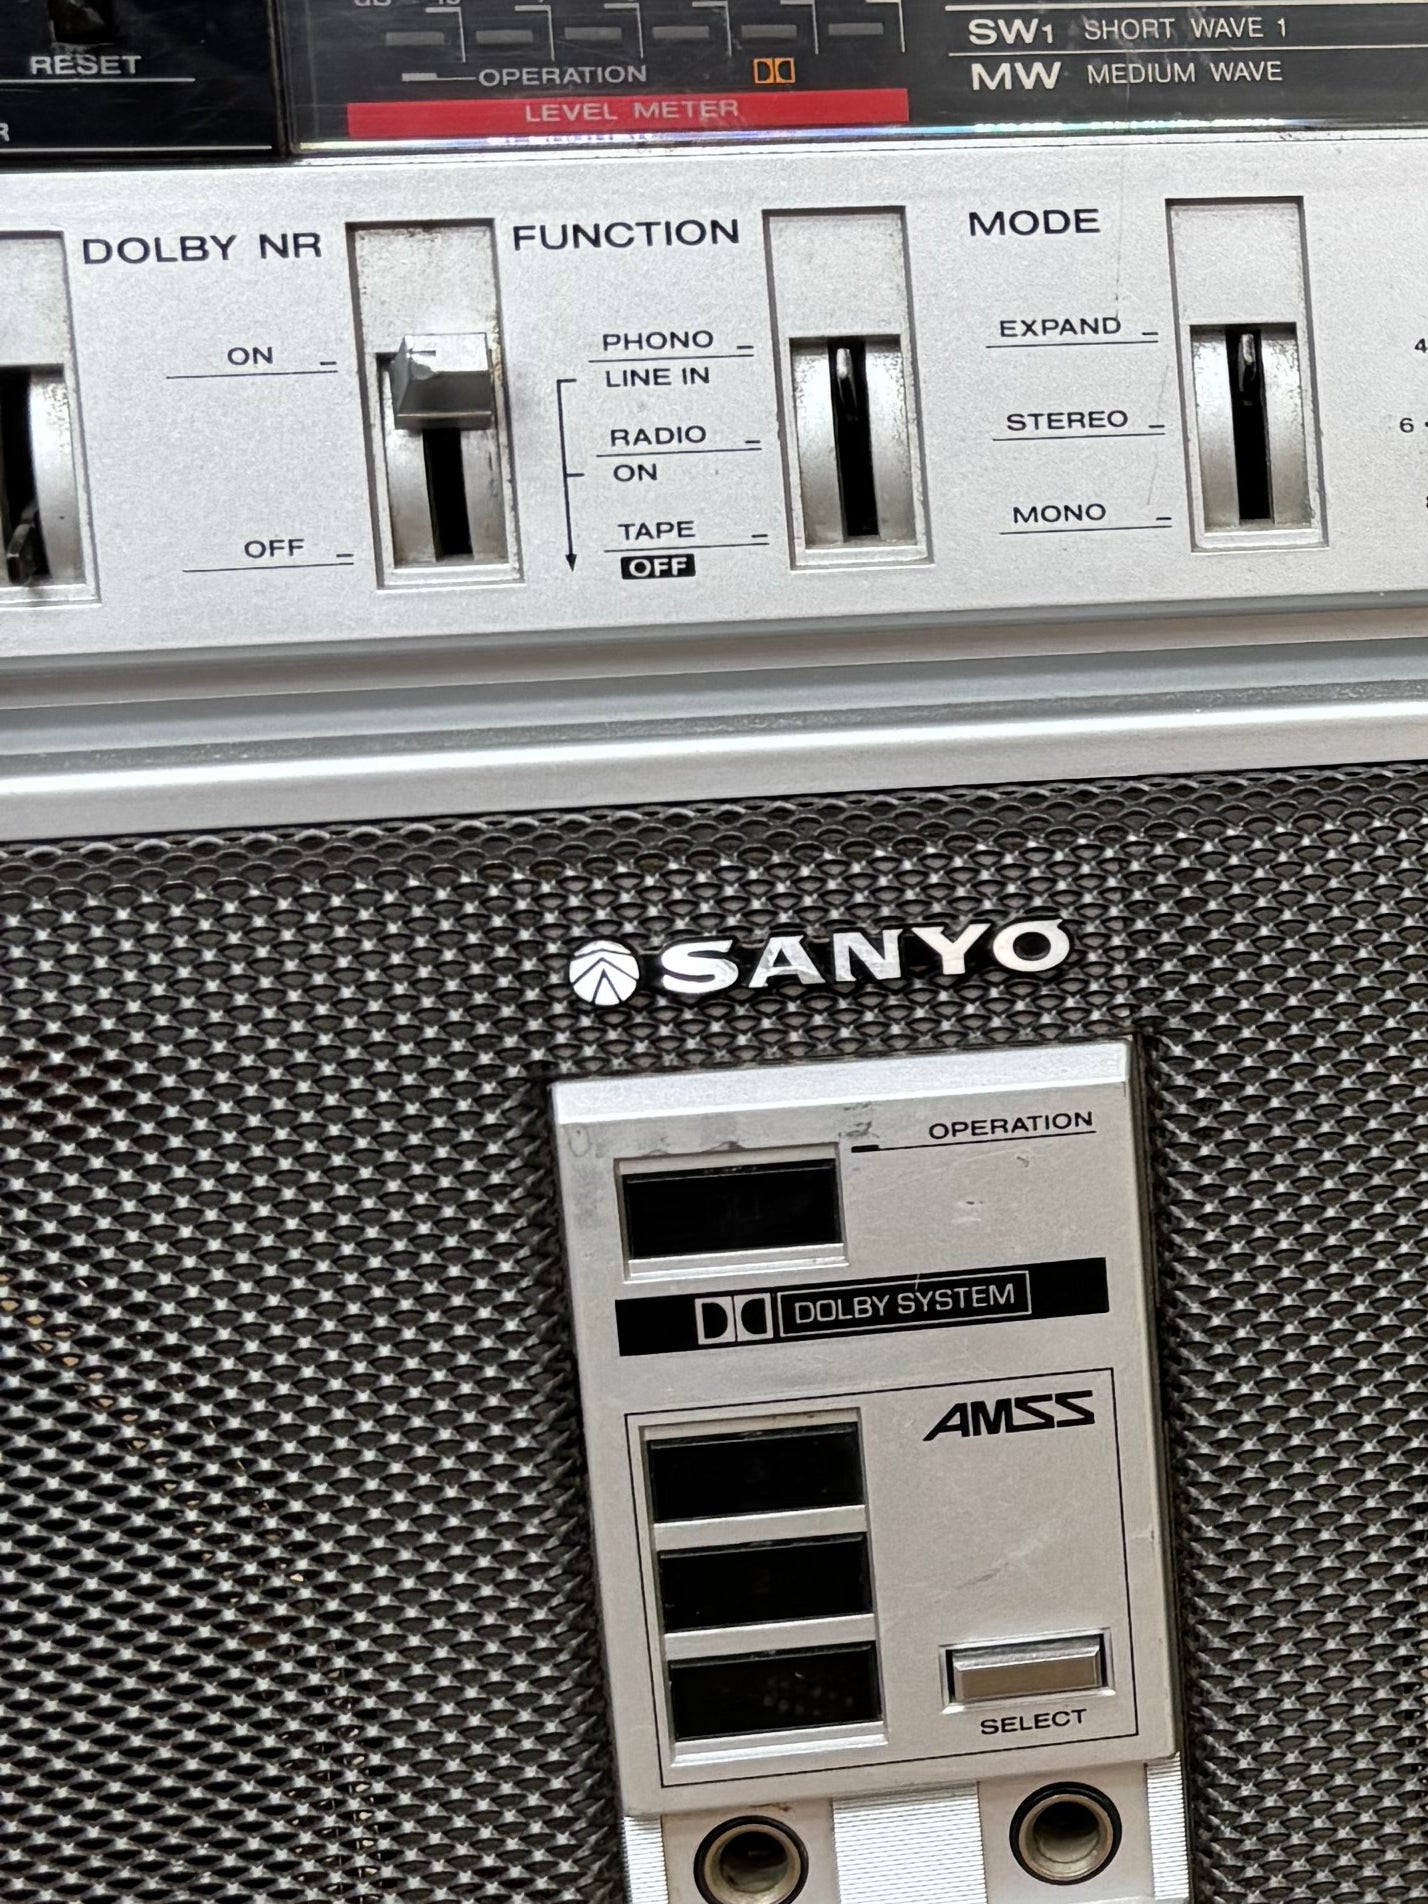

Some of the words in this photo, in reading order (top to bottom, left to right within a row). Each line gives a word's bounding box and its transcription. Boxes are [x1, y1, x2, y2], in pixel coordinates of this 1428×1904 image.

[967, 18, 1055, 46] SW1
[1083, 16, 1176, 41] SHORT
[1189, 15, 1265, 38] WAVE
[1278, 16, 1287, 37] 1
[29, 53, 142, 77] RESET
[477, 63, 648, 87] OPERATION
[970, 60, 1062, 91] MW
[1086, 61, 1197, 85] MEDIUM
[1209, 59, 1284, 83] WAVE
[524, 99, 618, 124] LEVEL
[632, 96, 740, 120] METER
[968, 208, 1101, 237] MODE
[513, 218, 740, 251] FUNCTION
[82, 234, 238, 265] DOLBY
[259, 232, 323, 259] NR
[999, 316, 1122, 338] EXPAND
[602, 330, 715, 352] PHONO
[1414, 338, 1428, 354] 4
[226, 346, 274, 366] ON
[605, 368, 672, 389] LINE
[681, 366, 710, 386] IN
[1005, 409, 1129, 432] STEREO
[1399, 418, 1415, 434] 6
[609, 425, 708, 447] RADIO
[613, 463, 659, 483] ON
[1012, 503, 1107, 525] MONO
[617, 520, 697, 541] TAPE
[244, 538, 306, 559] OFF
[628, 557, 689, 577] OFF
[660, 917, 1072, 995] SANYO
[928, 1111, 1095, 1141] OPERATION
[793, 1295, 890, 1327] DOLBY
[896, 1282, 1016, 1316] SYSTEM
[922, 1390, 1096, 1442] AMSS
[979, 1709, 1088, 1737] SELECT
